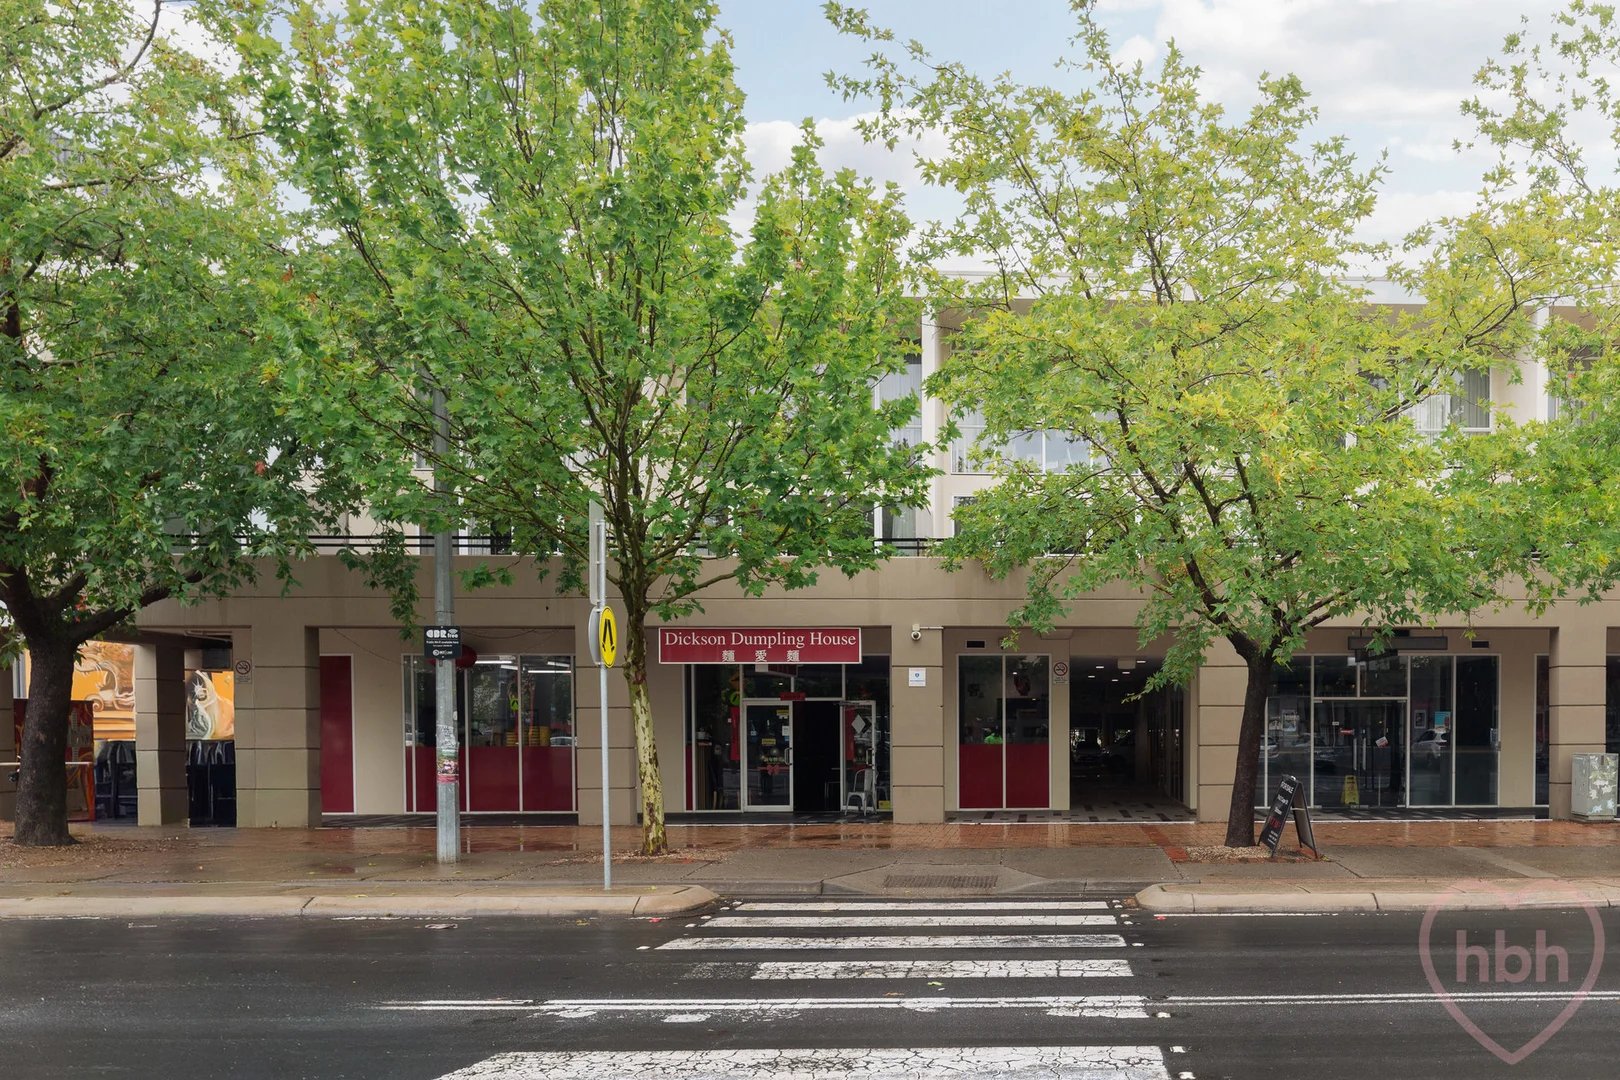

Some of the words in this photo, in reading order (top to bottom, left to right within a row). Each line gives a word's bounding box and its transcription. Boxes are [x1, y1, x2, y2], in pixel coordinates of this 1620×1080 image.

[426, 629, 446, 638] CBR
[665, 631, 726, 646] Dickson
[731, 631, 805, 649] Dumpling
[810, 631, 857, 646] House
